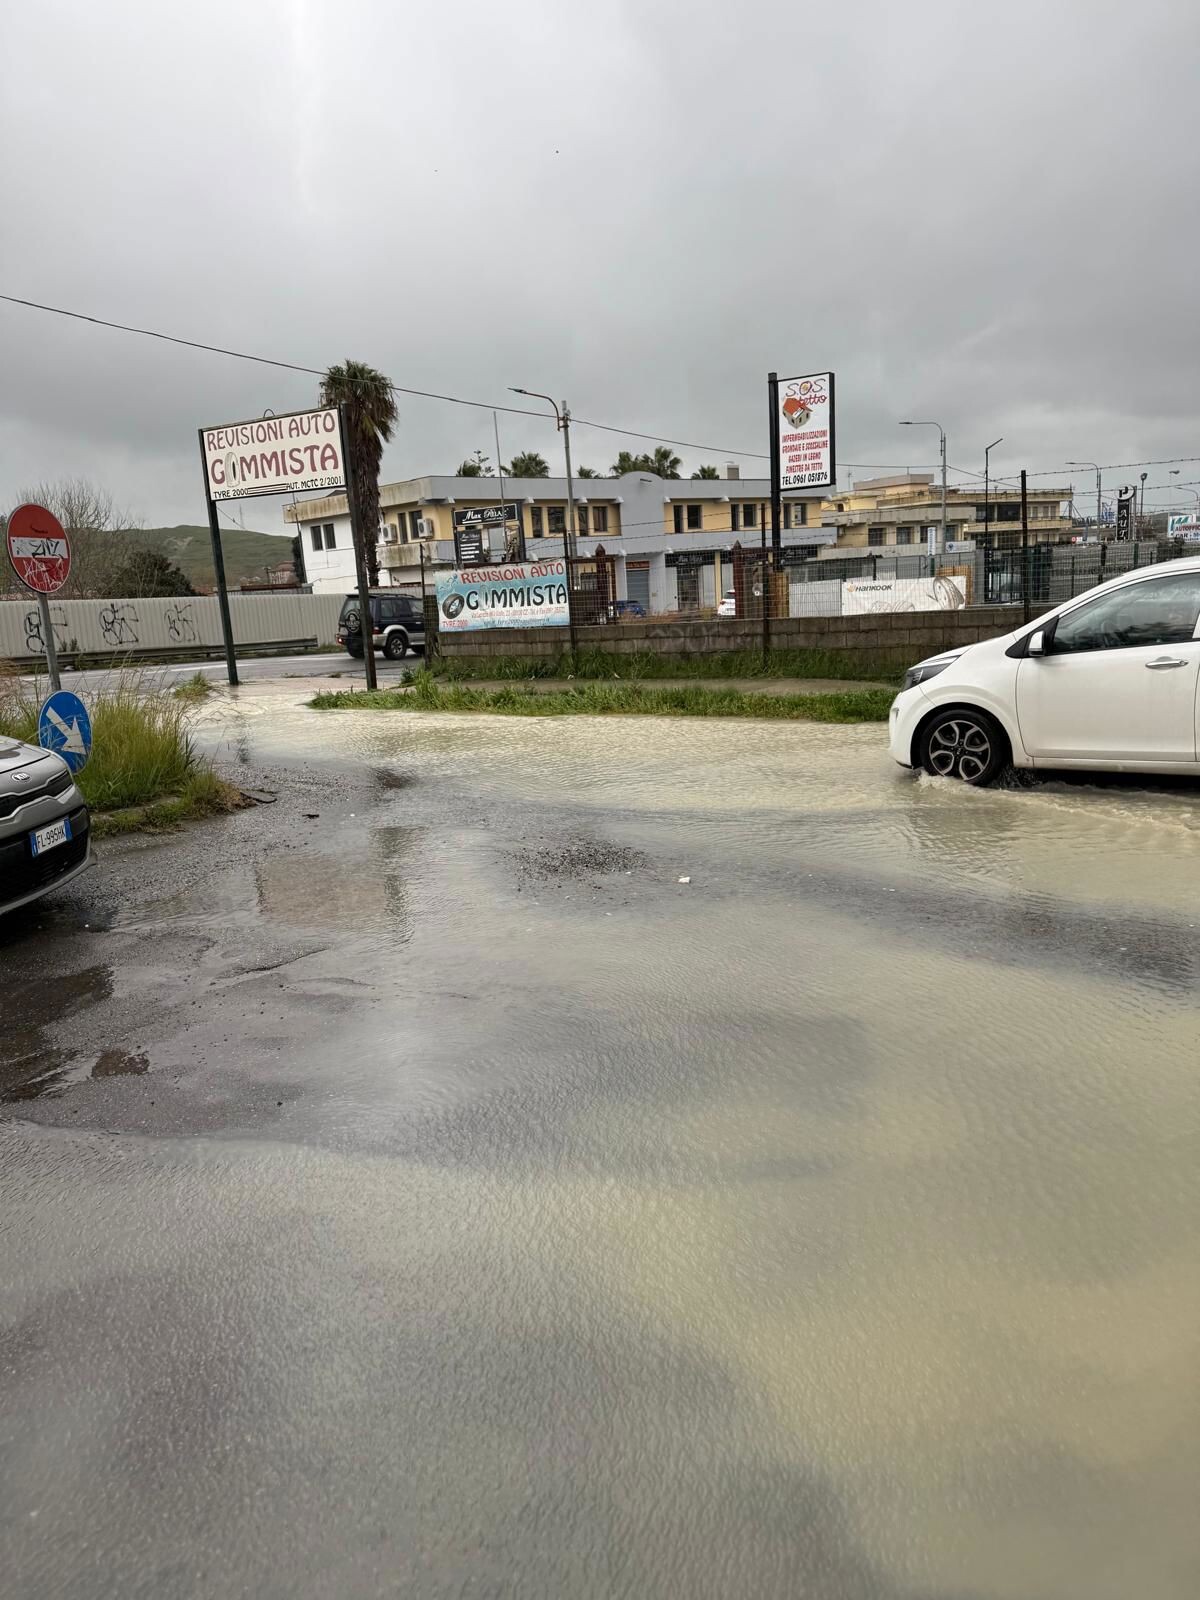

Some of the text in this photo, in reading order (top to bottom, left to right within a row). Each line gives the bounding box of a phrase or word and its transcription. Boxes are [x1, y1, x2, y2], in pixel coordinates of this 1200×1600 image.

[207, 412, 335, 451] REVISIONI AUTO
[782, 443, 802, 454] GRONDAIE
[805, 440, 828, 451] SCOSSALINE
[803, 453, 807, 461] IN
[808, 452, 821, 461] LEGNO
[786, 462, 823, 474] FINESTRE DA TETTO
[808, 472, 828, 483] 051876
[213, 489, 231, 498] TYRE
[232, 487, 249, 497] 2000
[301, 479, 318, 488] MCTC
[320, 476, 342, 486] 2/2001
[460, 562, 564, 584] REVISIONI AUTO
